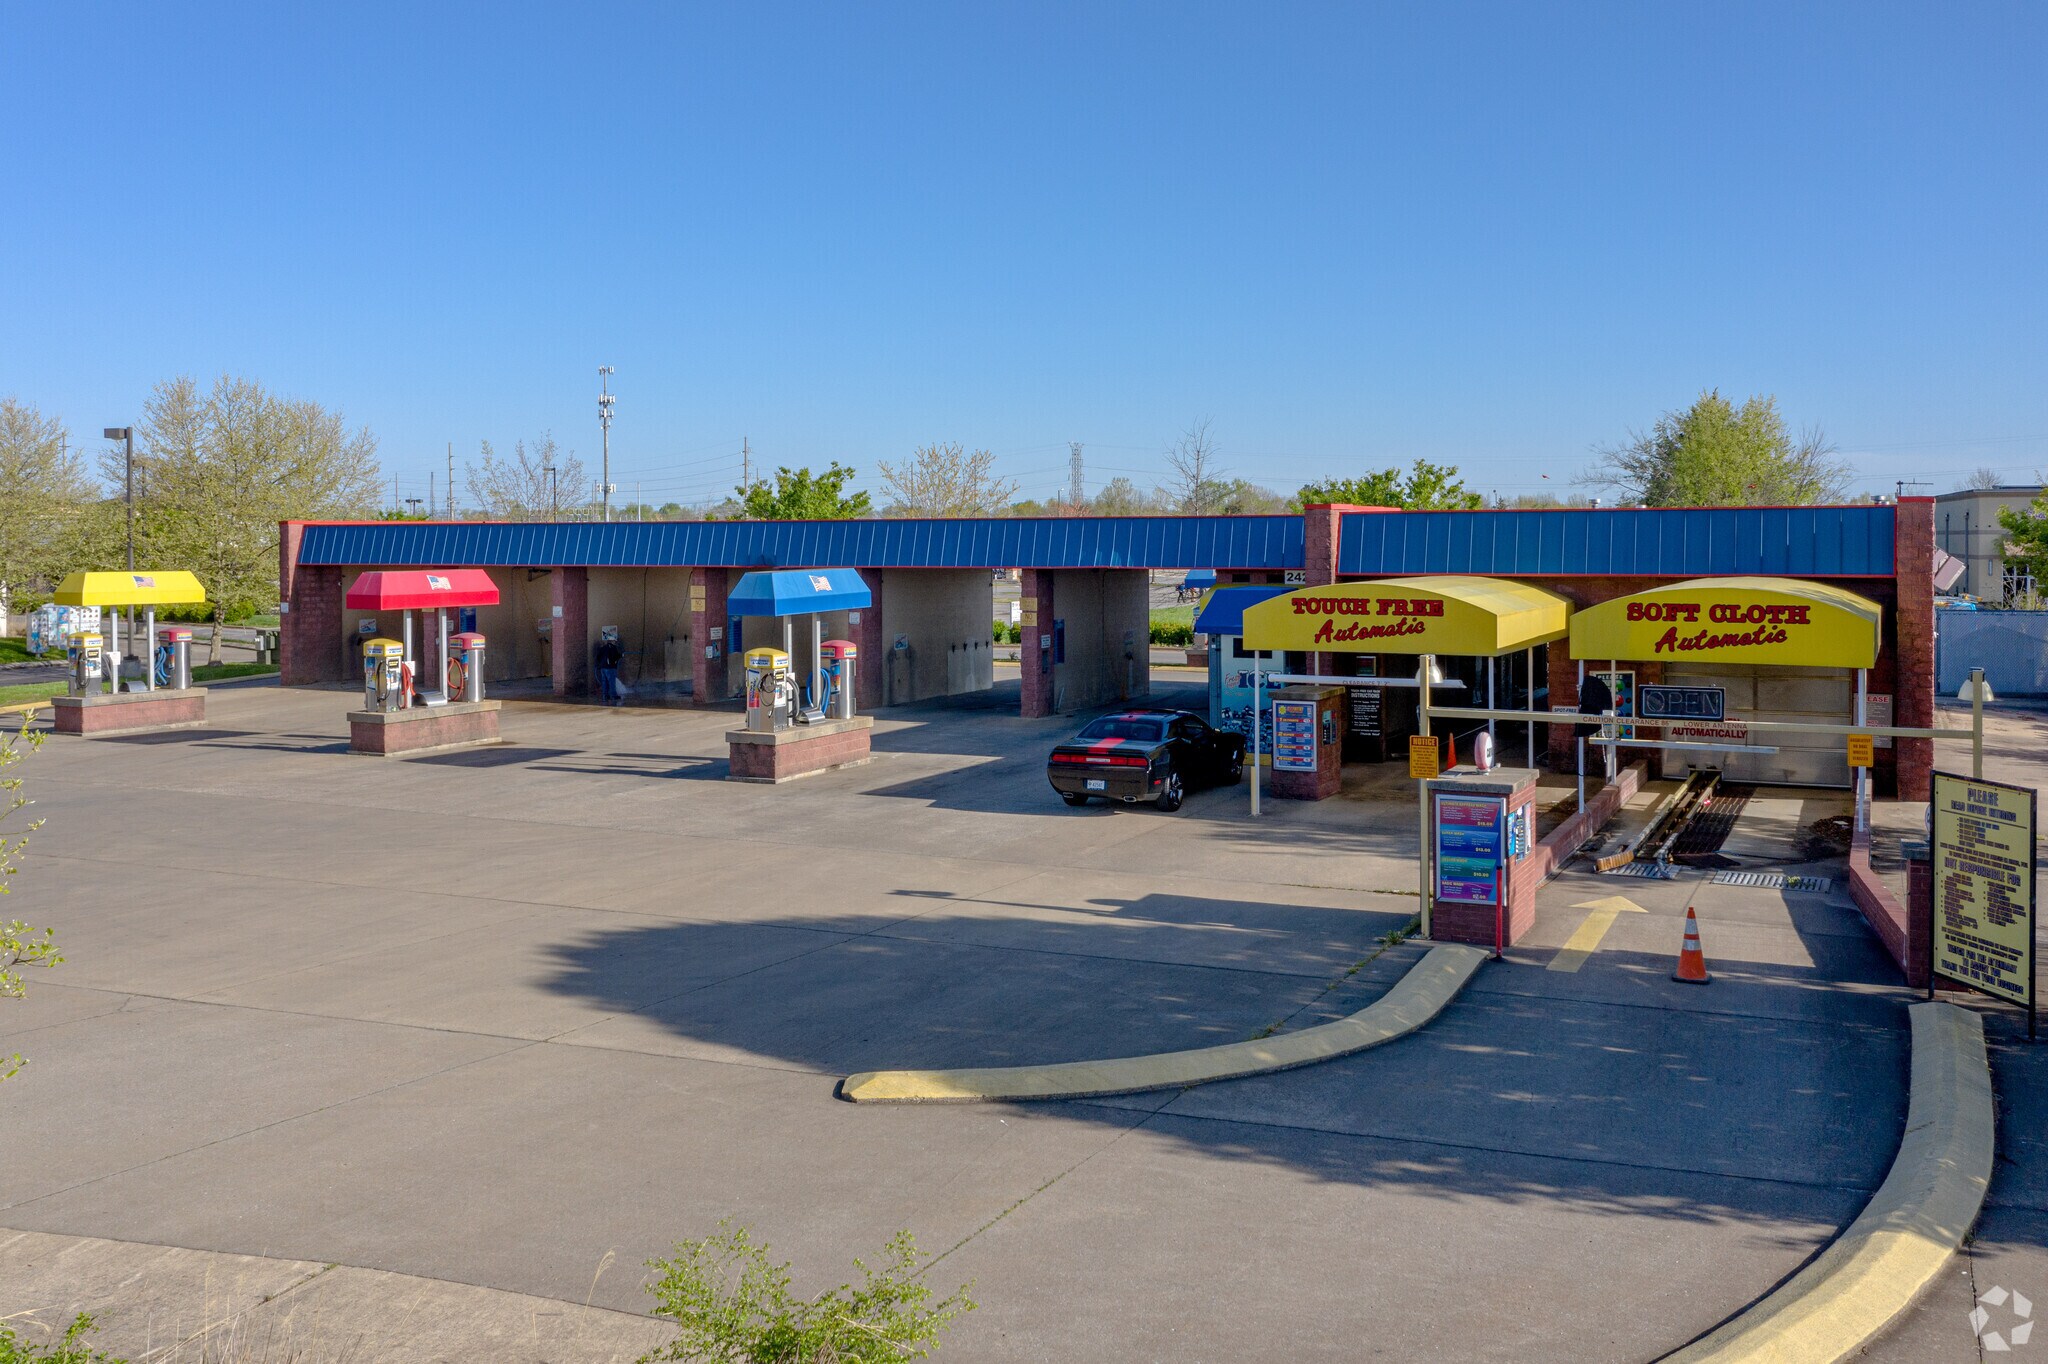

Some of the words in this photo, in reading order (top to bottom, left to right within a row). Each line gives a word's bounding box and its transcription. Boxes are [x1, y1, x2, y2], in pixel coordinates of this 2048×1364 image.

[1291, 597, 1370, 615] TOUCH
[1376, 599, 1444, 617] FREE
[1626, 602, 1701, 622] SOFT
[1709, 604, 1811, 624] CLOTH
[1314, 617, 1426, 644] Automatic
[1654, 625, 1788, 653] Automatic
[1238, 670, 1282, 689] ICE
[1646, 691, 1719, 715] OPEN
[1582, 716, 1614, 724] CAUTION
[1616, 717, 1660, 726] CLEARANCE
[1412, 737, 1436, 746] NOTICE
[1671, 727, 1748, 739] AUTOMATICALLY
[1967, 788, 1999, 807] PLEASE
[1951, 800, 1966, 812] READ
[1966, 803, 1988, 816] BEFORE
[1988, 807, 2017, 823] ENTERING
[1944, 856, 1958, 870] NOT
[1959, 860, 2006, 882] RESPONSIBLE
[2007, 872, 2021, 887] FOR
[1958, 964, 1969, 977] YOU
